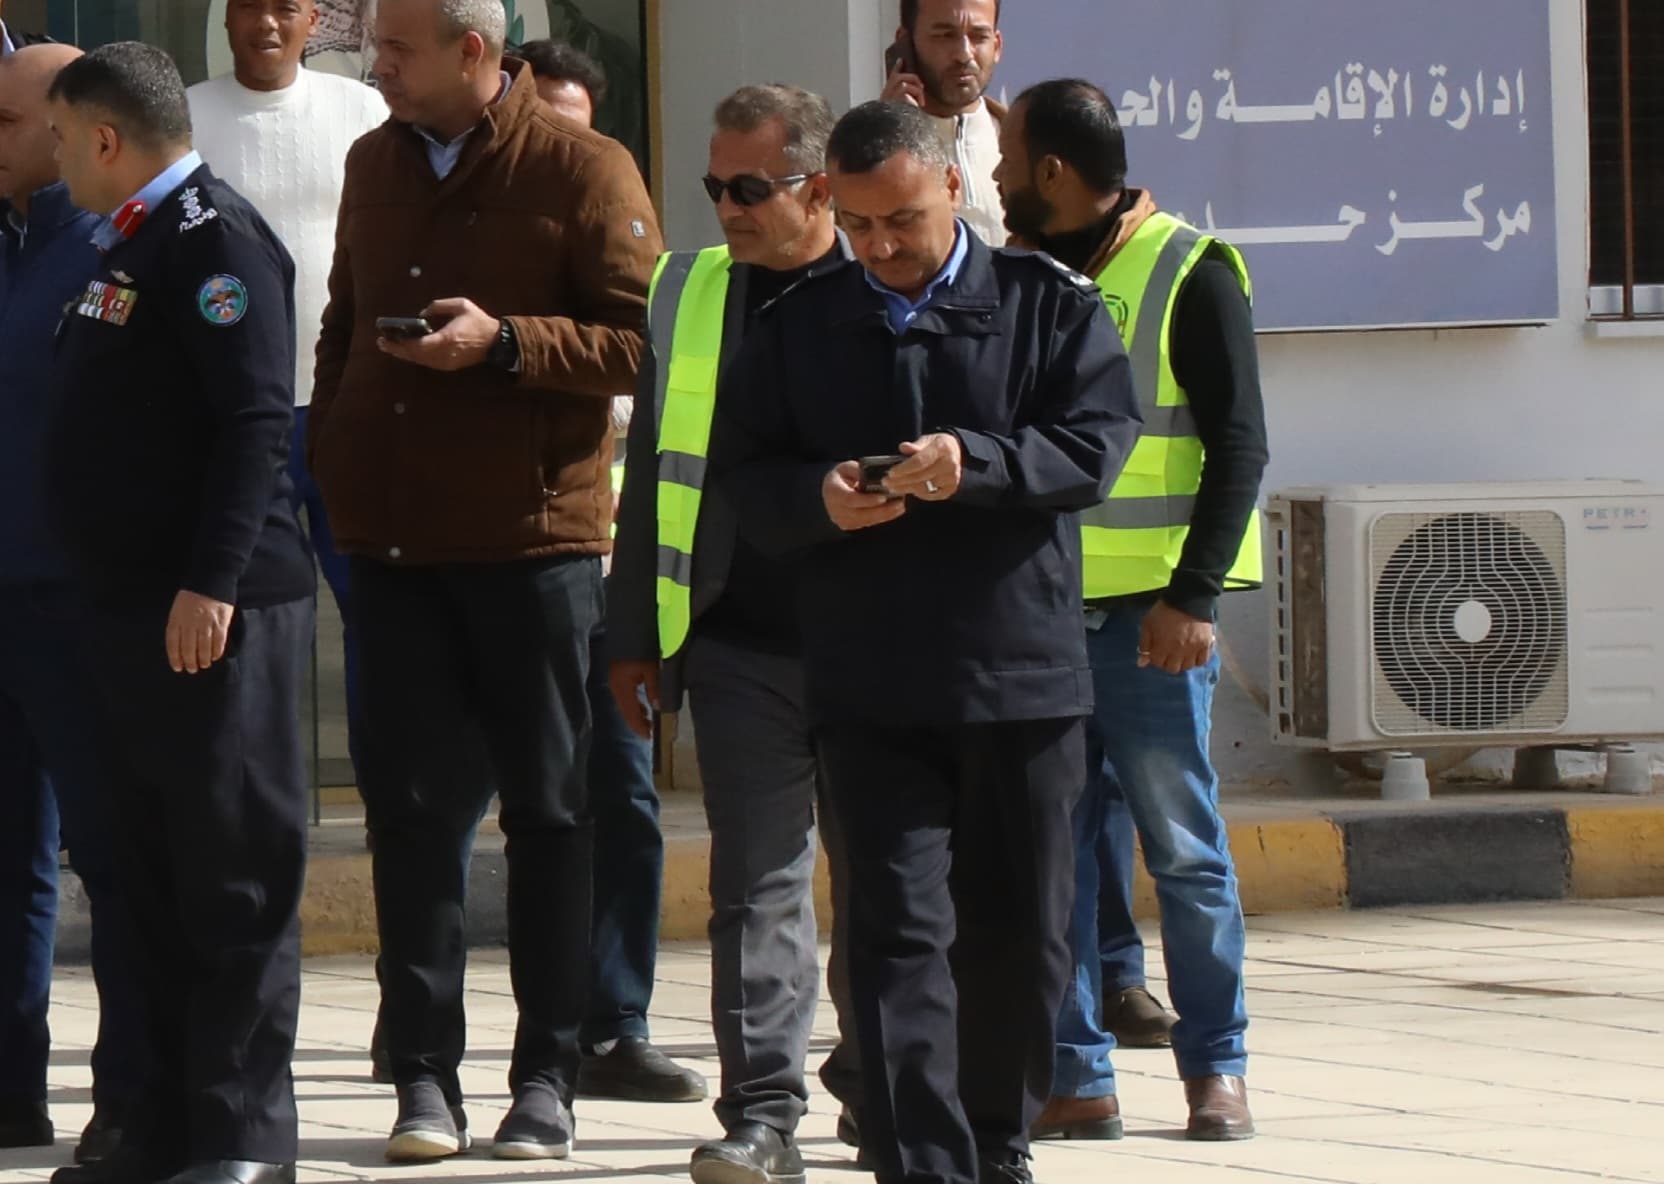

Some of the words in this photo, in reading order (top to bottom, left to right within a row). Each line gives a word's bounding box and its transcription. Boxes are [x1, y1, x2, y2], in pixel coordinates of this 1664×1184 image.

[1212, 63, 1412, 136] الإقامة
[1429, 64, 1528, 136] إدارة
[1374, 183, 1532, 257] مركز
